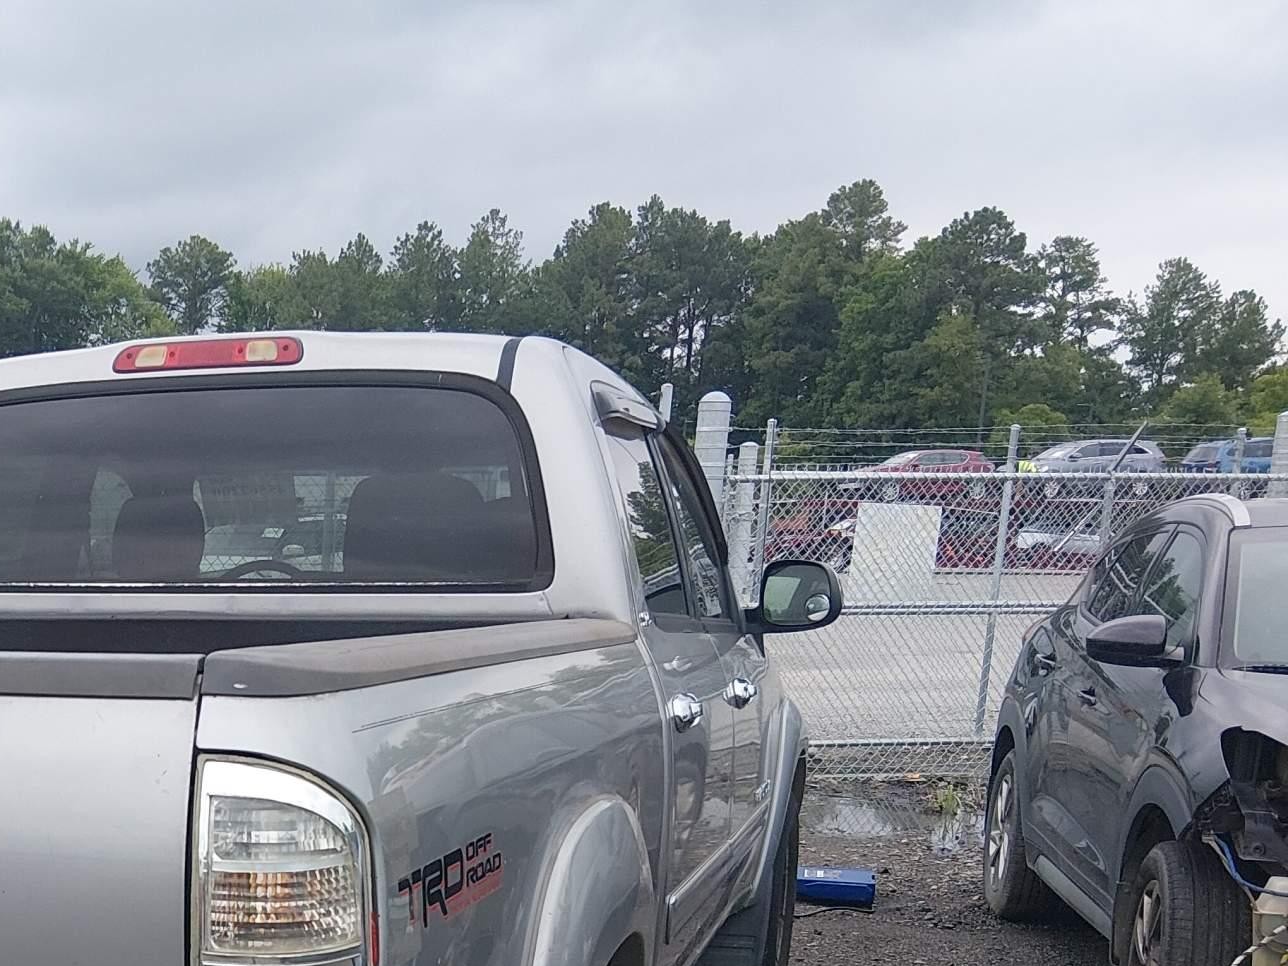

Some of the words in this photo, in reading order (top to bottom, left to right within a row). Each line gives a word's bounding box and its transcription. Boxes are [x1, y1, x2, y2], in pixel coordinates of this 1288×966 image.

[465, 832, 492, 861] OFF
[398, 848, 464, 928] TRD
[466, 852, 502, 888] ROAD
